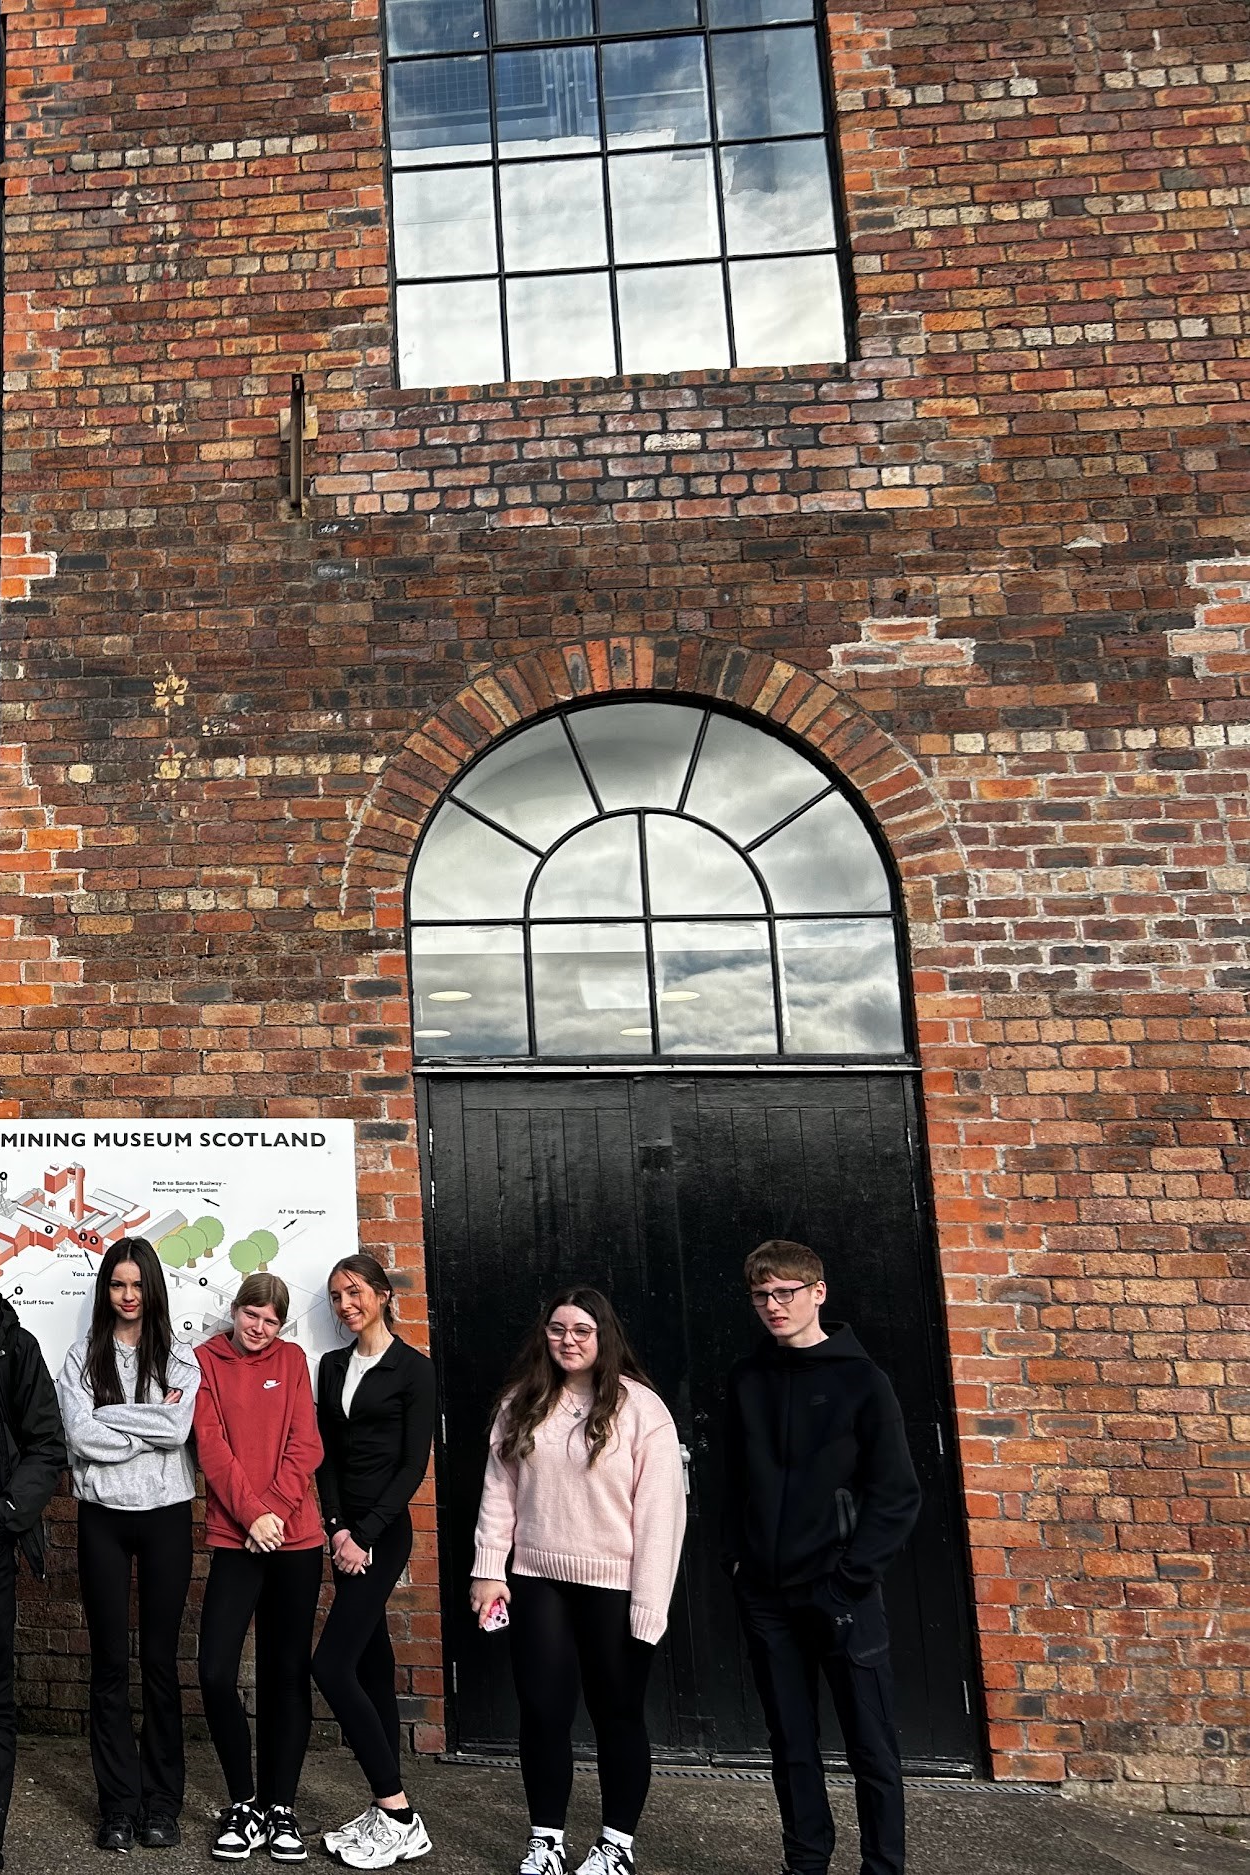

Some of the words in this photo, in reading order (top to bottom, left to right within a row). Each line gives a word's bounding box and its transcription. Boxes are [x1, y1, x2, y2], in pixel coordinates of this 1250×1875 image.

[1, 1132, 86, 1148] MINING
[93, 1132, 192, 1148] MUSEUM
[199, 1132, 326, 1148] SCOTLAND
